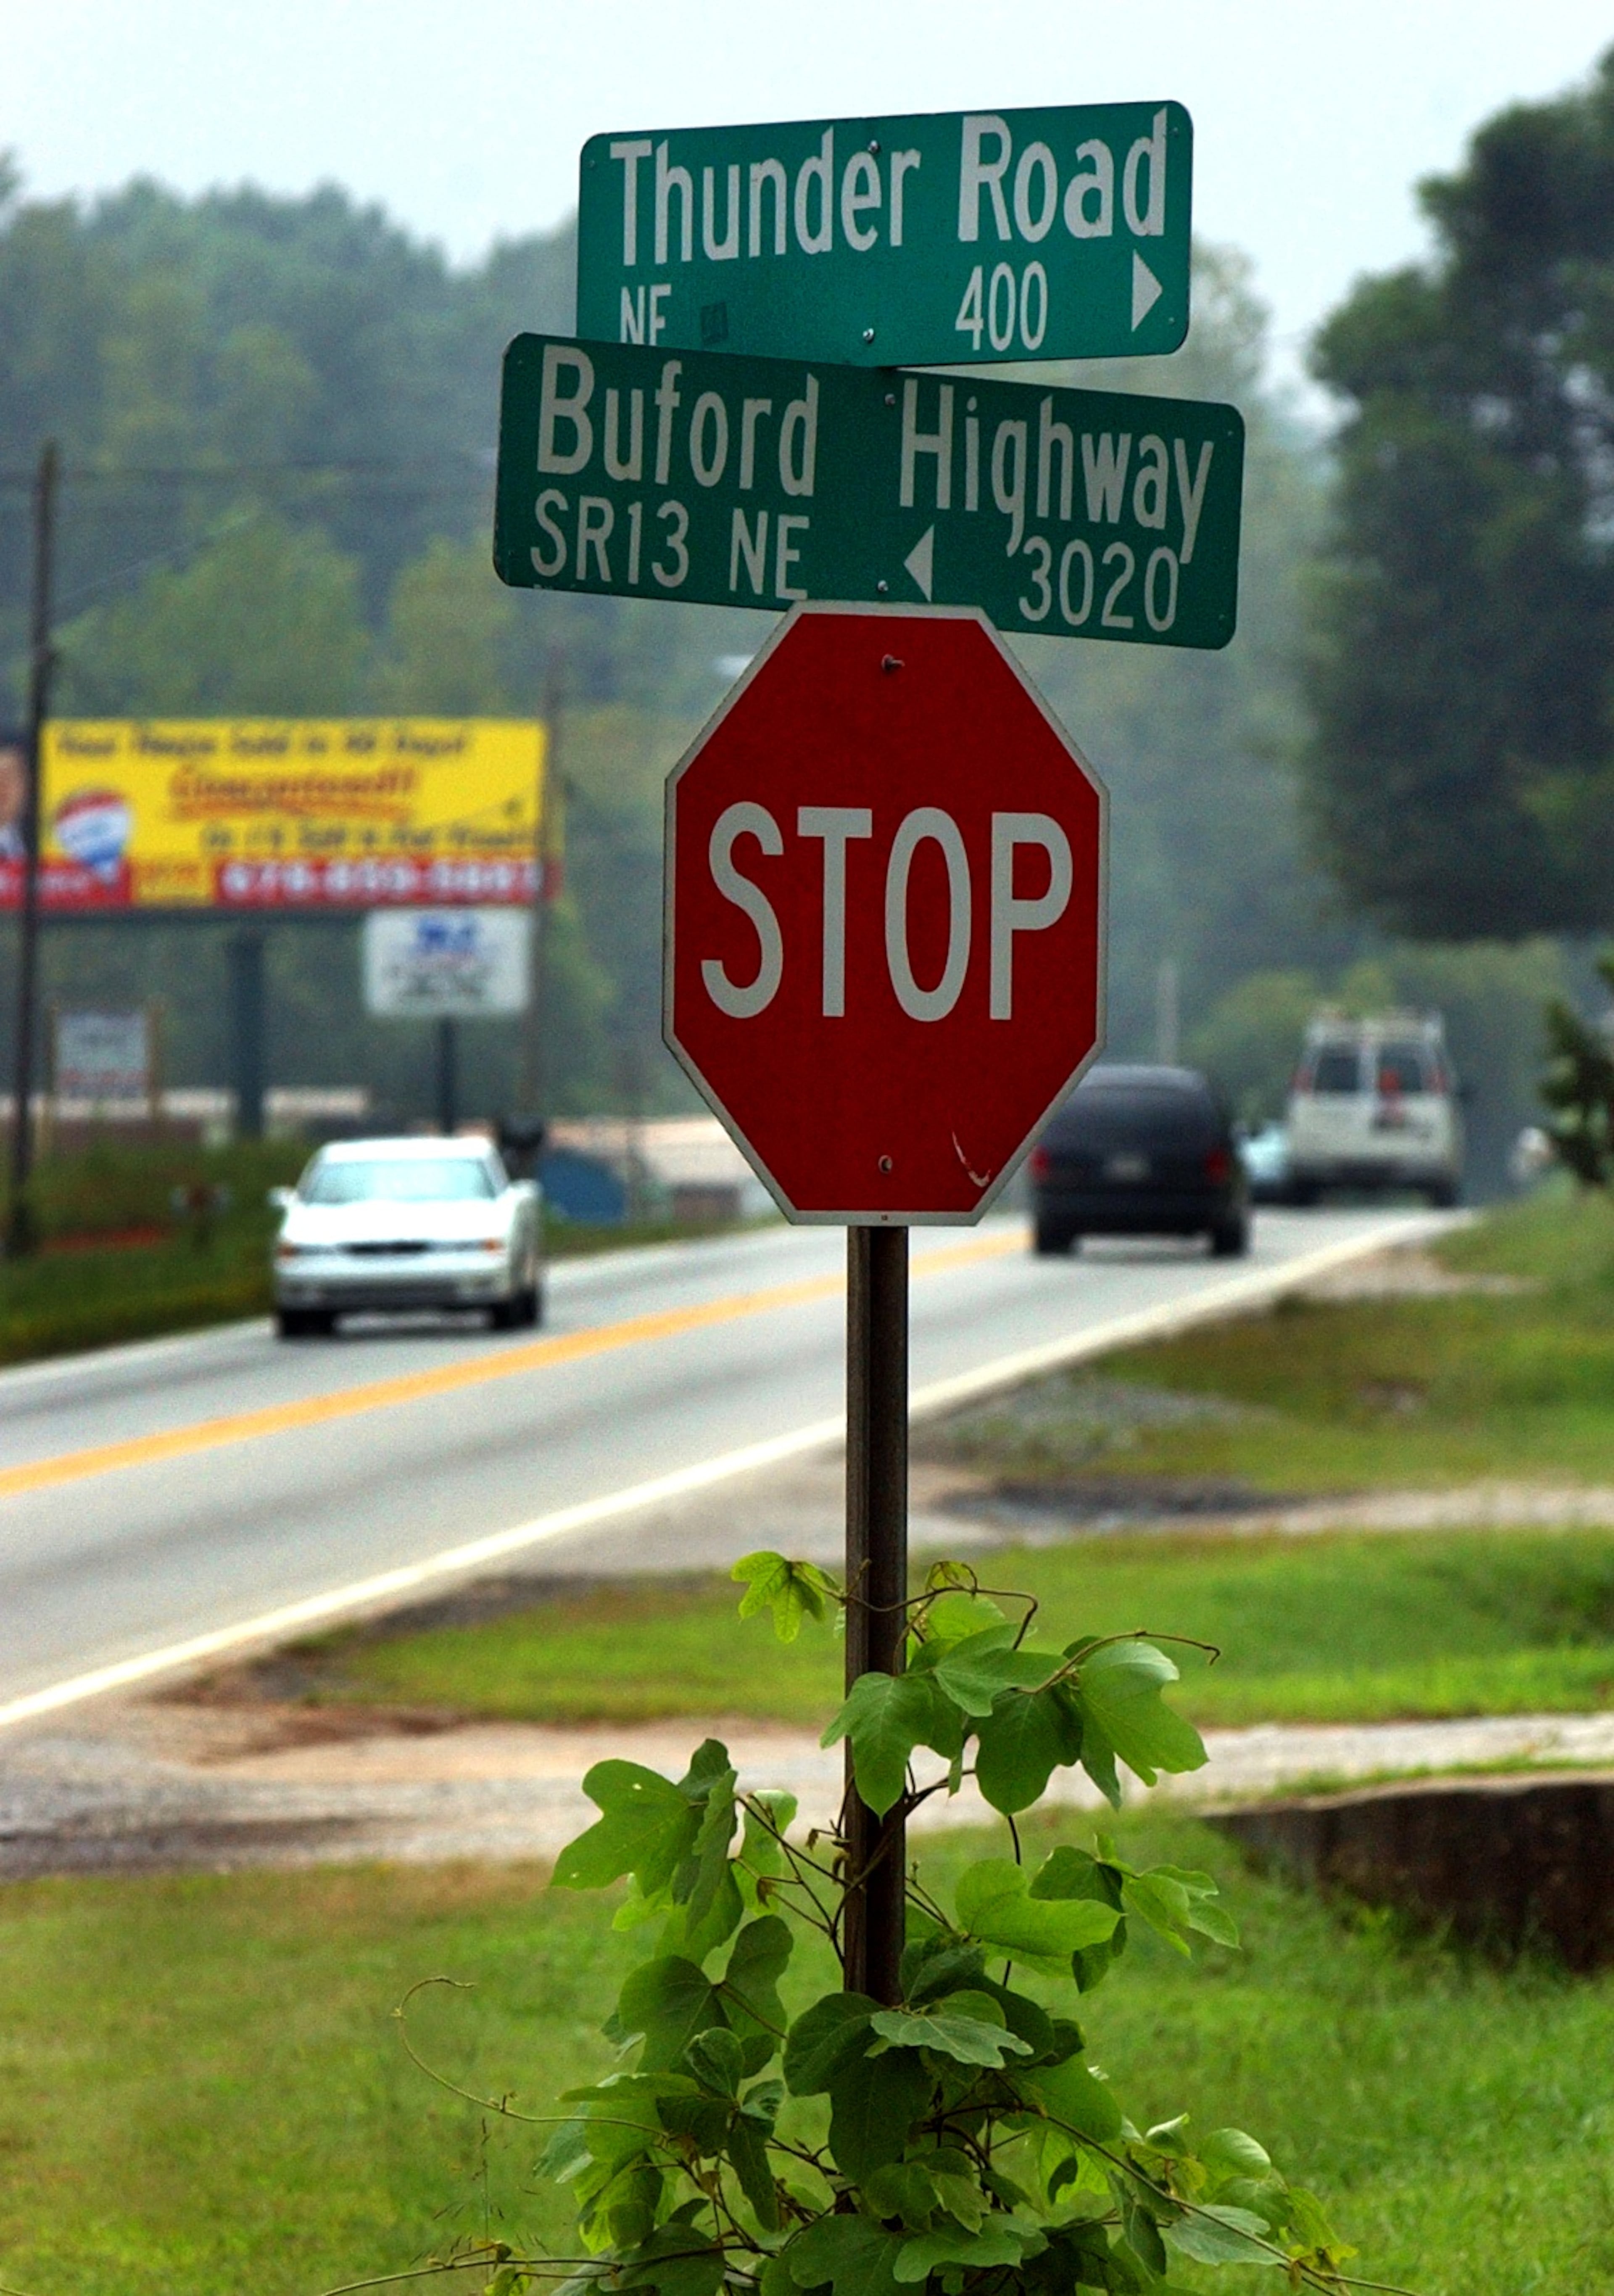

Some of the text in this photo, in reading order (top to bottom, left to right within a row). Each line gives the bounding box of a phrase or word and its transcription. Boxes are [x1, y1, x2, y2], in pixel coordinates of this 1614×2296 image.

[610, 106, 1167, 266] Thunder Road
[955, 261, 1048, 351] 400
[537, 345, 1213, 565] Buford Highway
[530, 489, 1180, 631] SR13 NE 3020
[700, 801, 1074, 1023] STOP
